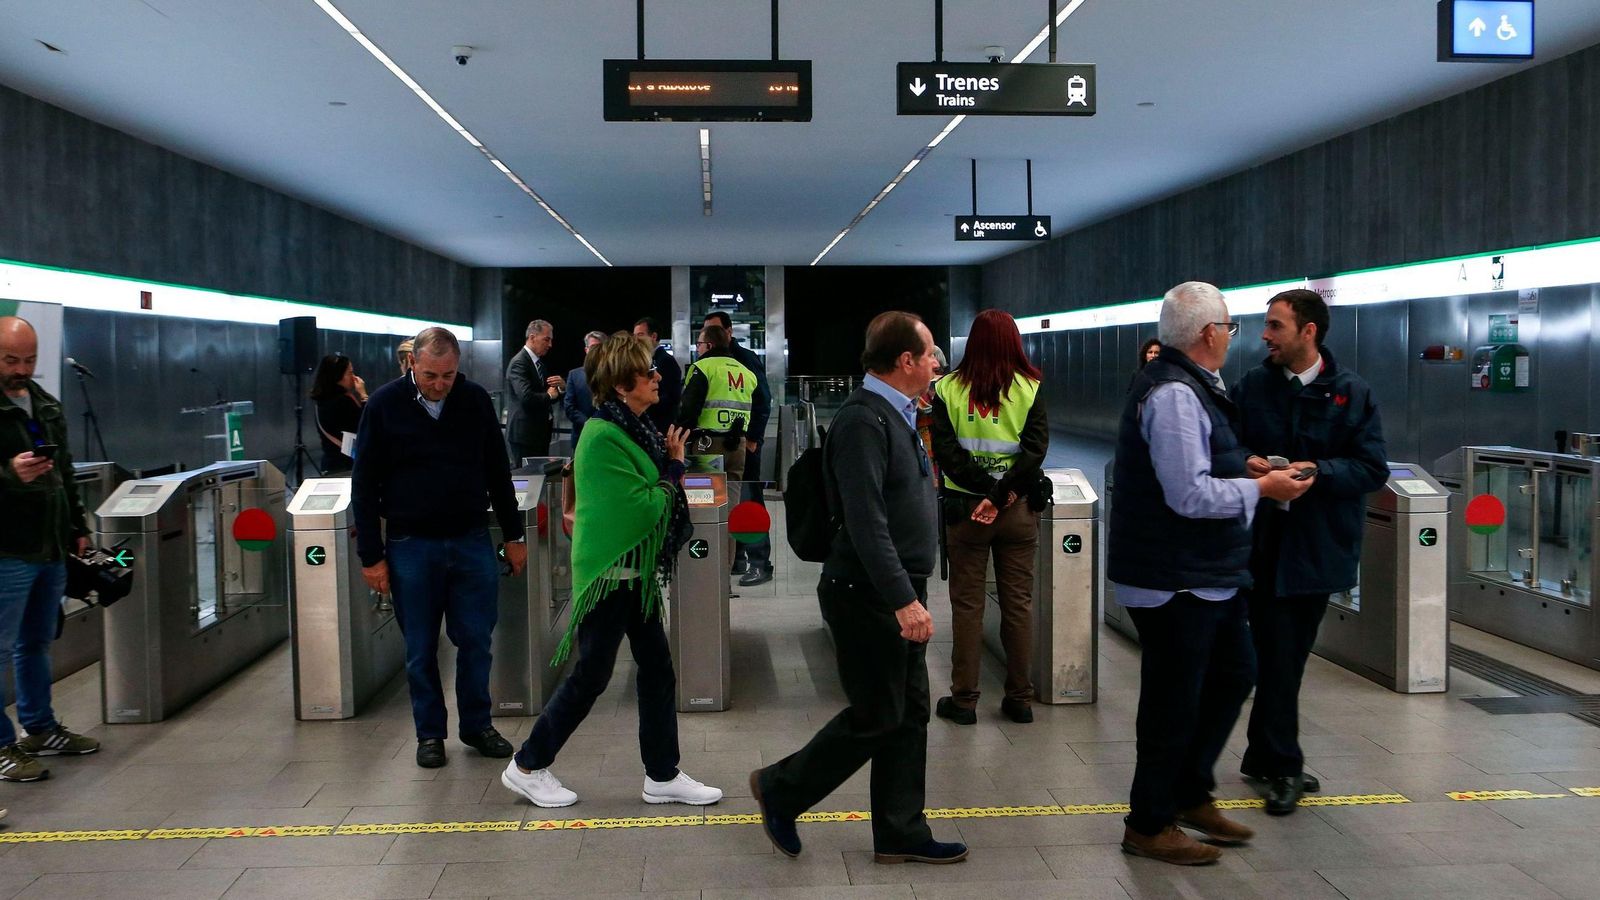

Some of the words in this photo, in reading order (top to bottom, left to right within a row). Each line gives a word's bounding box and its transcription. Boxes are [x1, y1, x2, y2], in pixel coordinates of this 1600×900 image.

[936, 74, 999, 91] Trenes
[936, 94, 975, 106] Trains
[973, 220, 1016, 230] Ascensor
[727, 371, 745, 393] M
